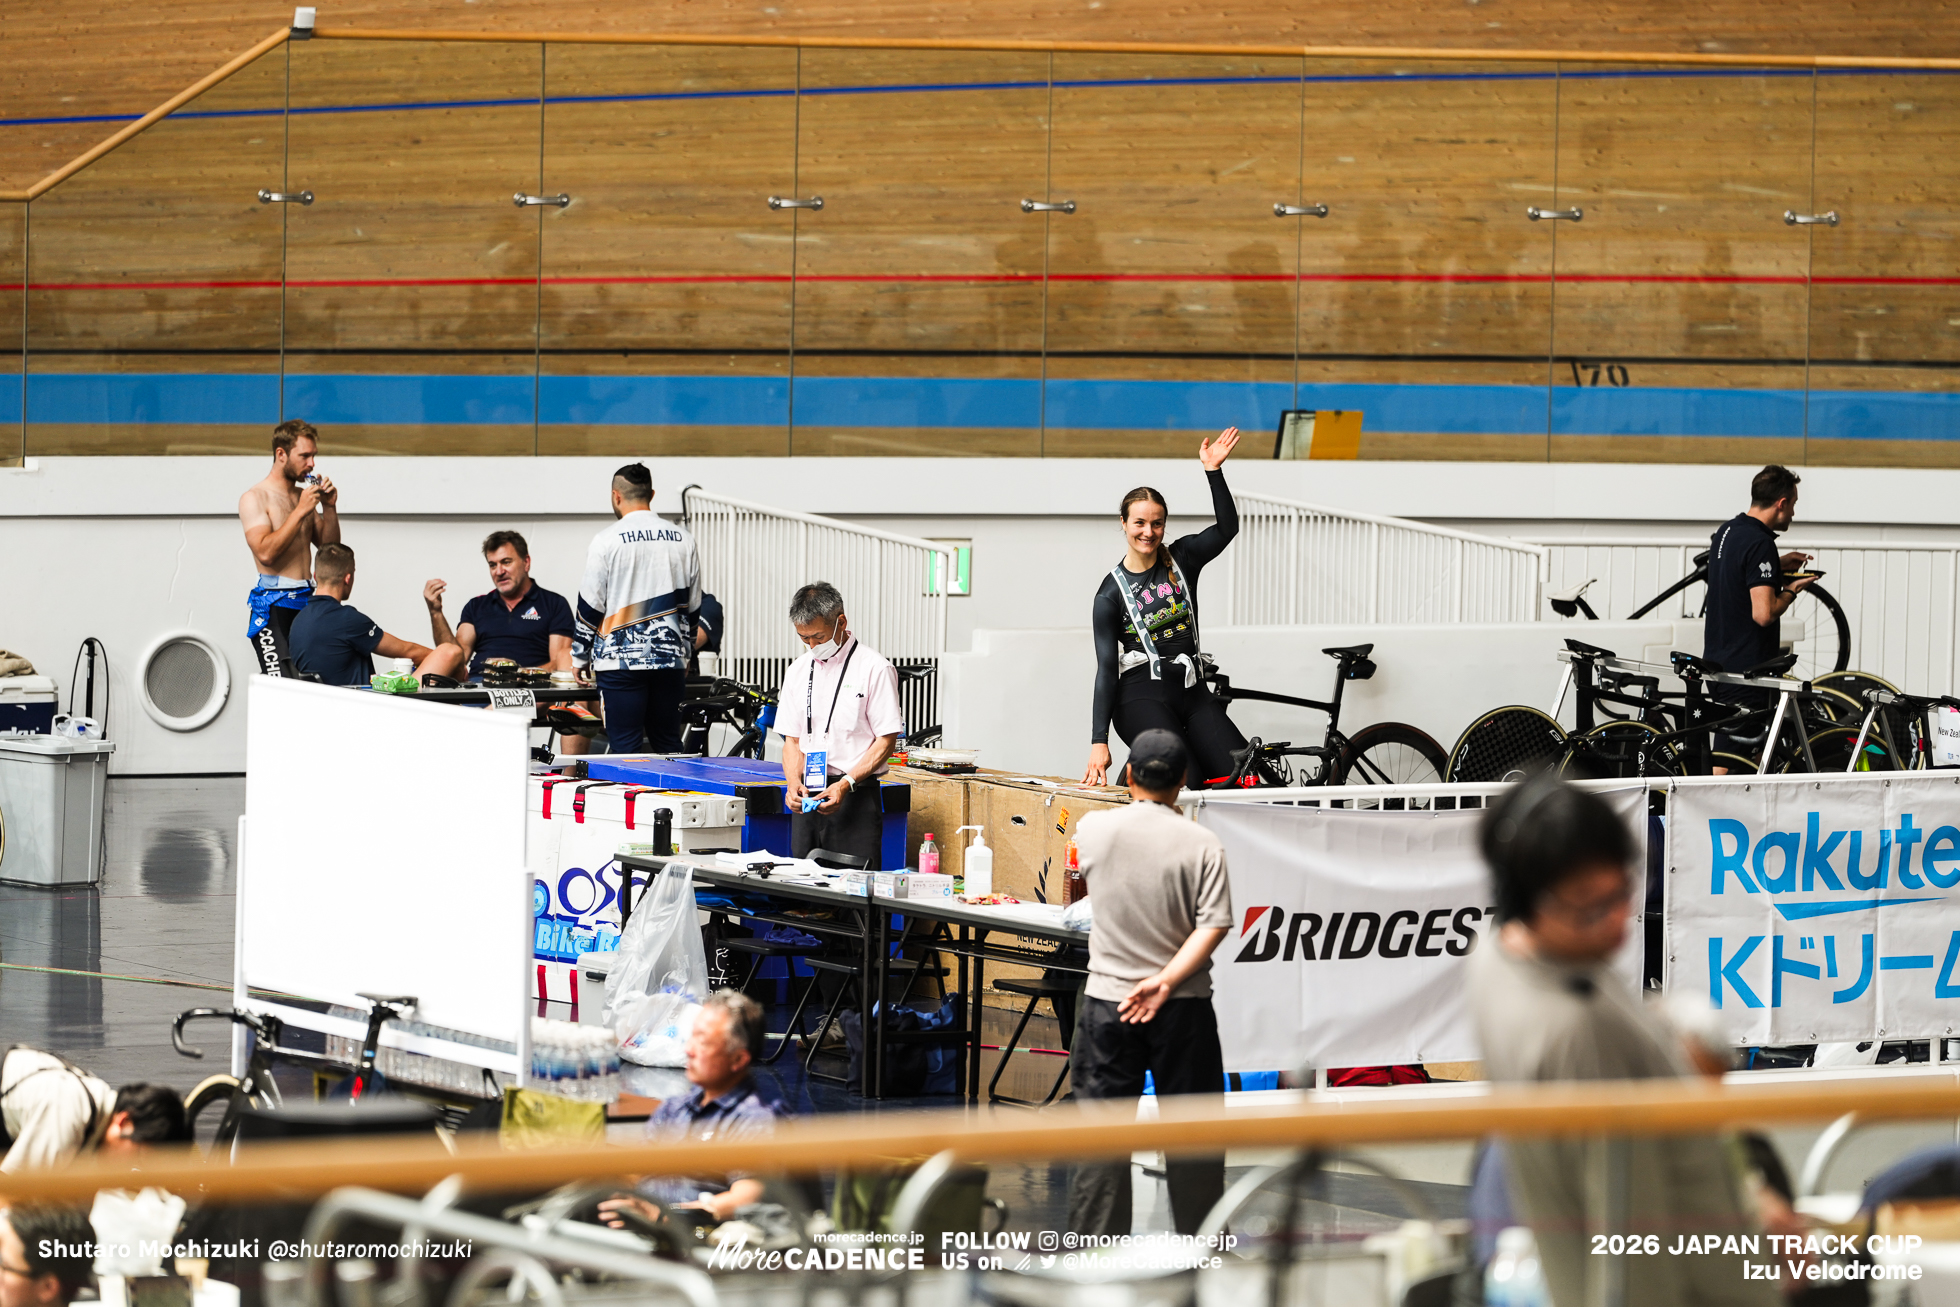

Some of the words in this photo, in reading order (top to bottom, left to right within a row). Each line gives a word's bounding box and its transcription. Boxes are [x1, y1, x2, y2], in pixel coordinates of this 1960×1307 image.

[619, 529, 683, 544] THAILAND
[503, 697, 523, 706] ONLY
[1938, 727, 1949, 736] New
